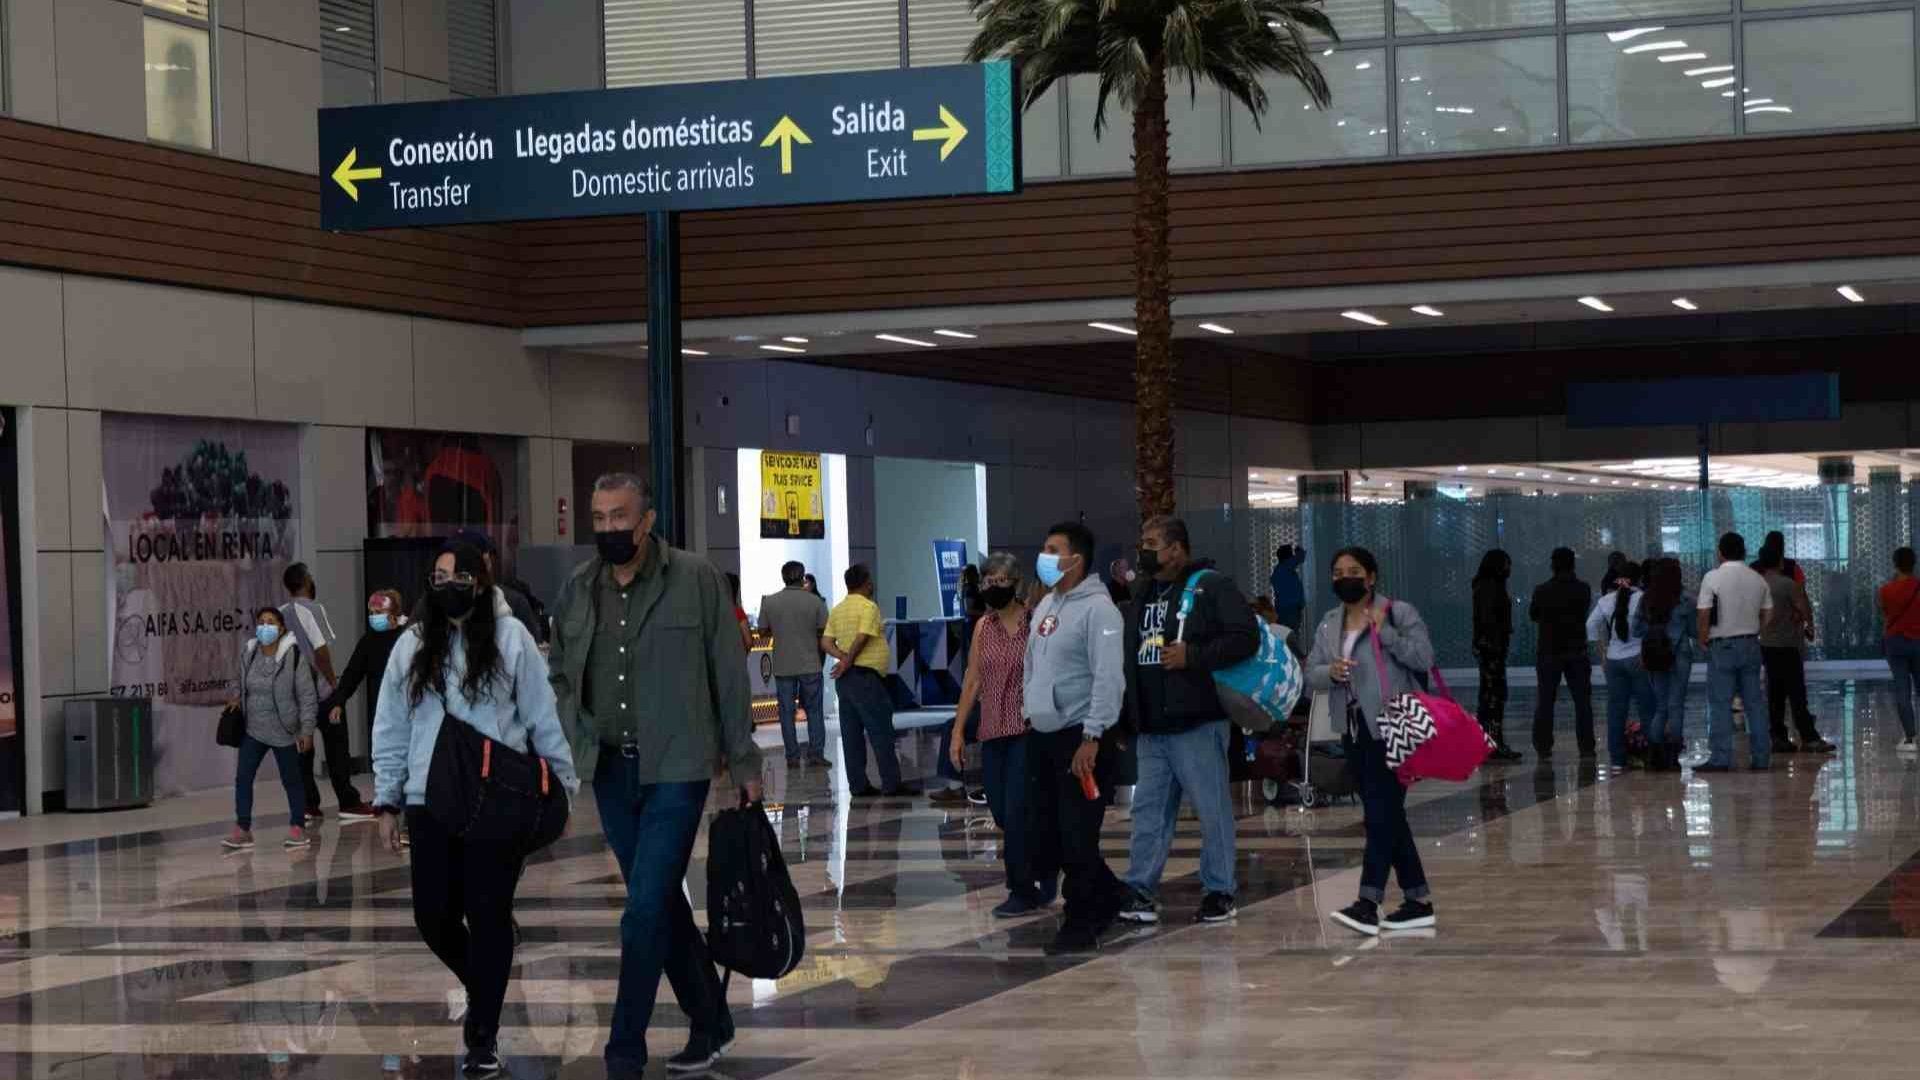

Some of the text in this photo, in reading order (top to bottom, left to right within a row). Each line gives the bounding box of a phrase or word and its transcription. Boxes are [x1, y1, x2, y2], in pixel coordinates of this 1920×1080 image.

[830, 101, 907, 137] Salida
[389, 136, 494, 167] Conexión
[515, 117, 755, 164] Llegadas domésticas
[571, 159, 755, 199] Domestic arrivals
[866, 147, 909, 179] Exit
[389, 181, 472, 210] Transfer
[128, 529, 274, 564] LOCAL EN RENTA
[144, 612, 179, 637] AIFA
[182, 610, 209, 635] S.A.
